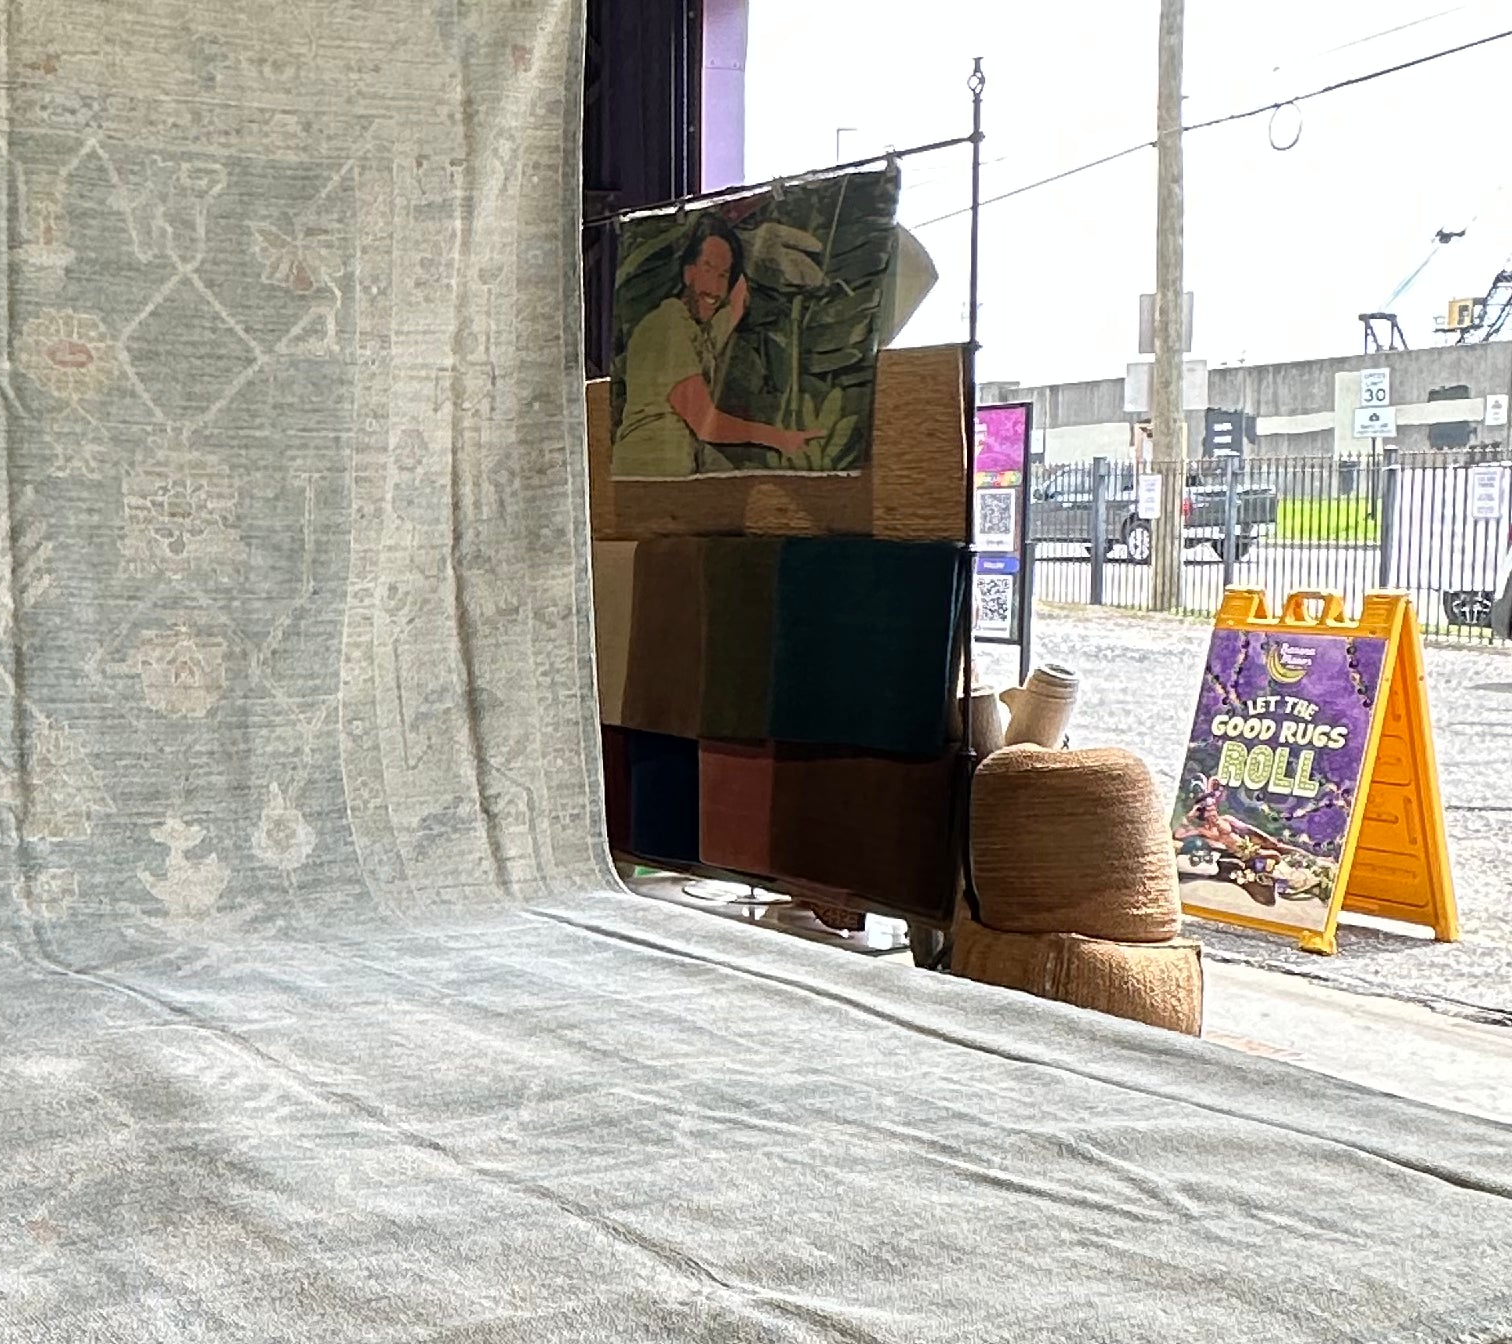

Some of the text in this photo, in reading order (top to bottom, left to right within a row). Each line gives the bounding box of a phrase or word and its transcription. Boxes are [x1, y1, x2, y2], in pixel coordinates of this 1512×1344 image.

[1363, 388, 1386, 402] 30
[1246, 695, 1319, 721] LET THE
[1211, 714, 1349, 749] GOOD RUGS
[1217, 740, 1320, 798] ROLL
